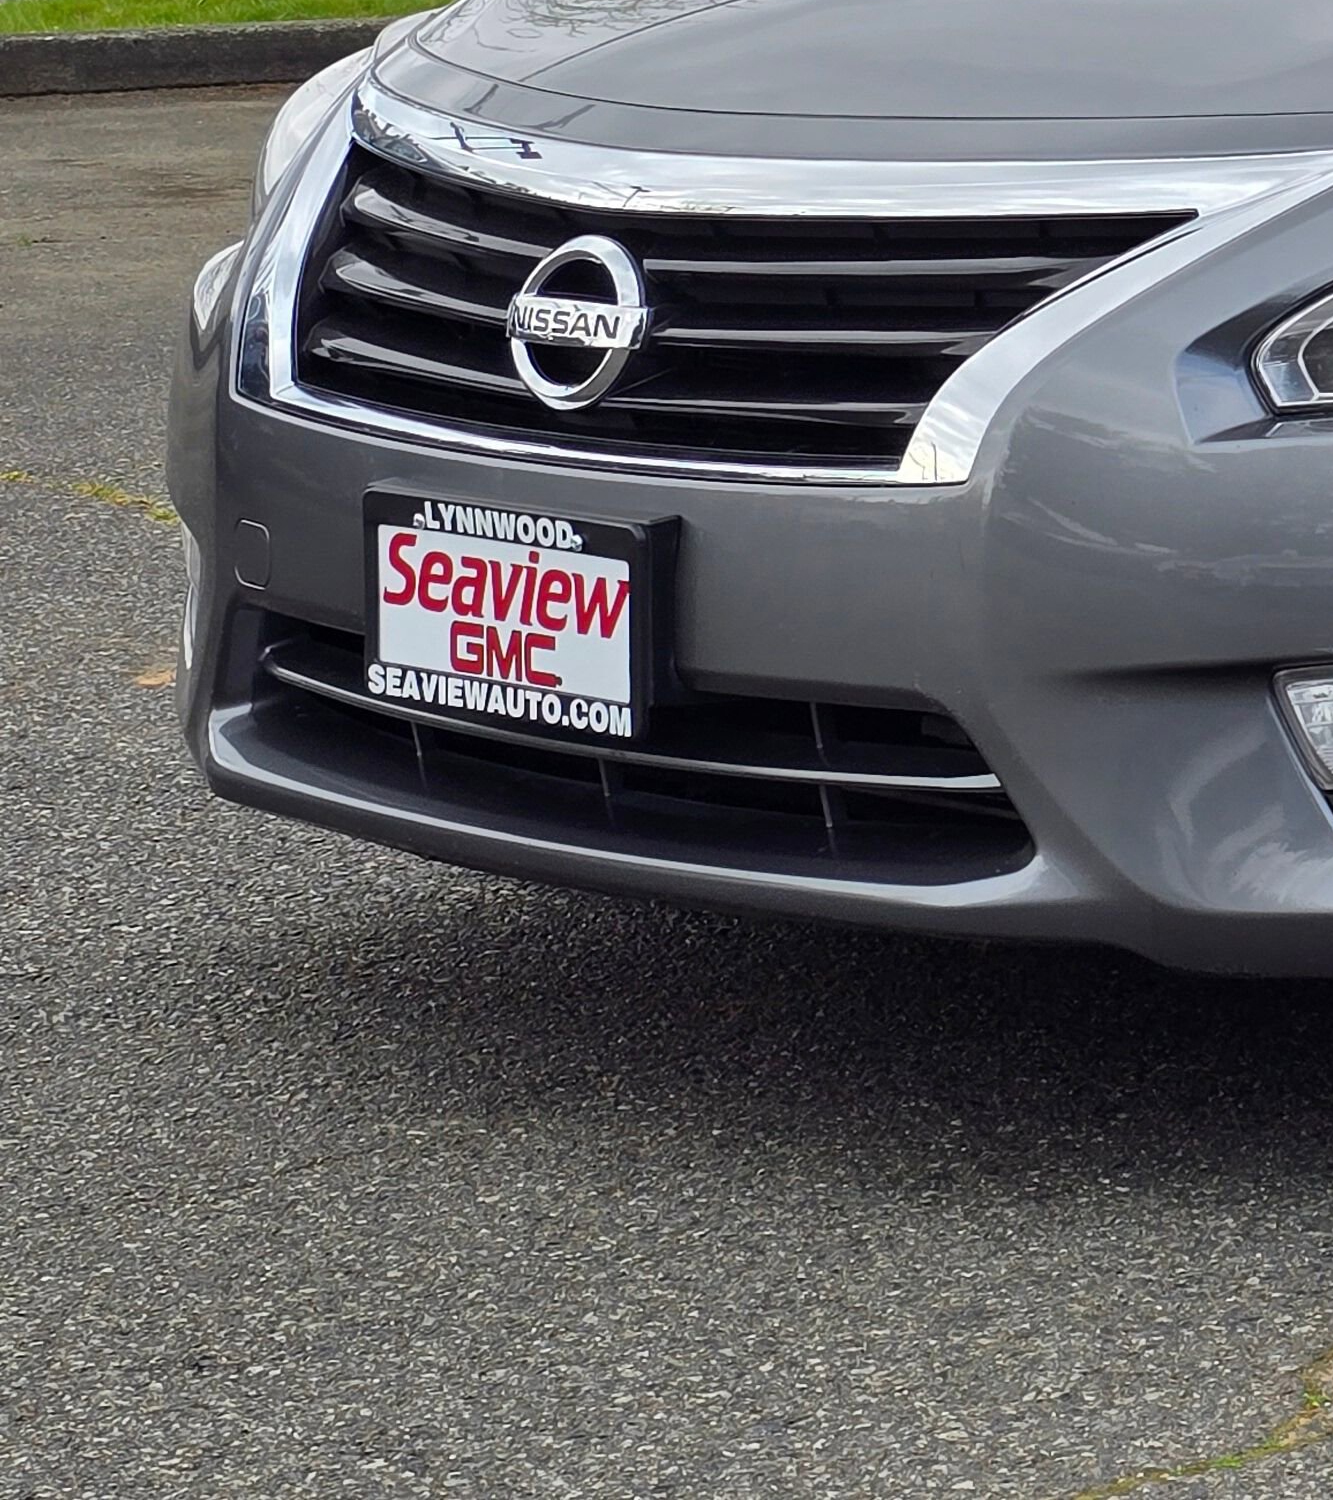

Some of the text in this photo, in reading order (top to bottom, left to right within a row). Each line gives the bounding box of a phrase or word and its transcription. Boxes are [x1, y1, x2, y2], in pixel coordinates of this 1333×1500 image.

[514, 304, 621, 340] NISSAN
[423, 501, 574, 550] LYNNWOOD
[382, 531, 631, 639] Seaview
[450, 620, 560, 689] GMC
[367, 663, 633, 738] SEAVIEWAUTO.COM
